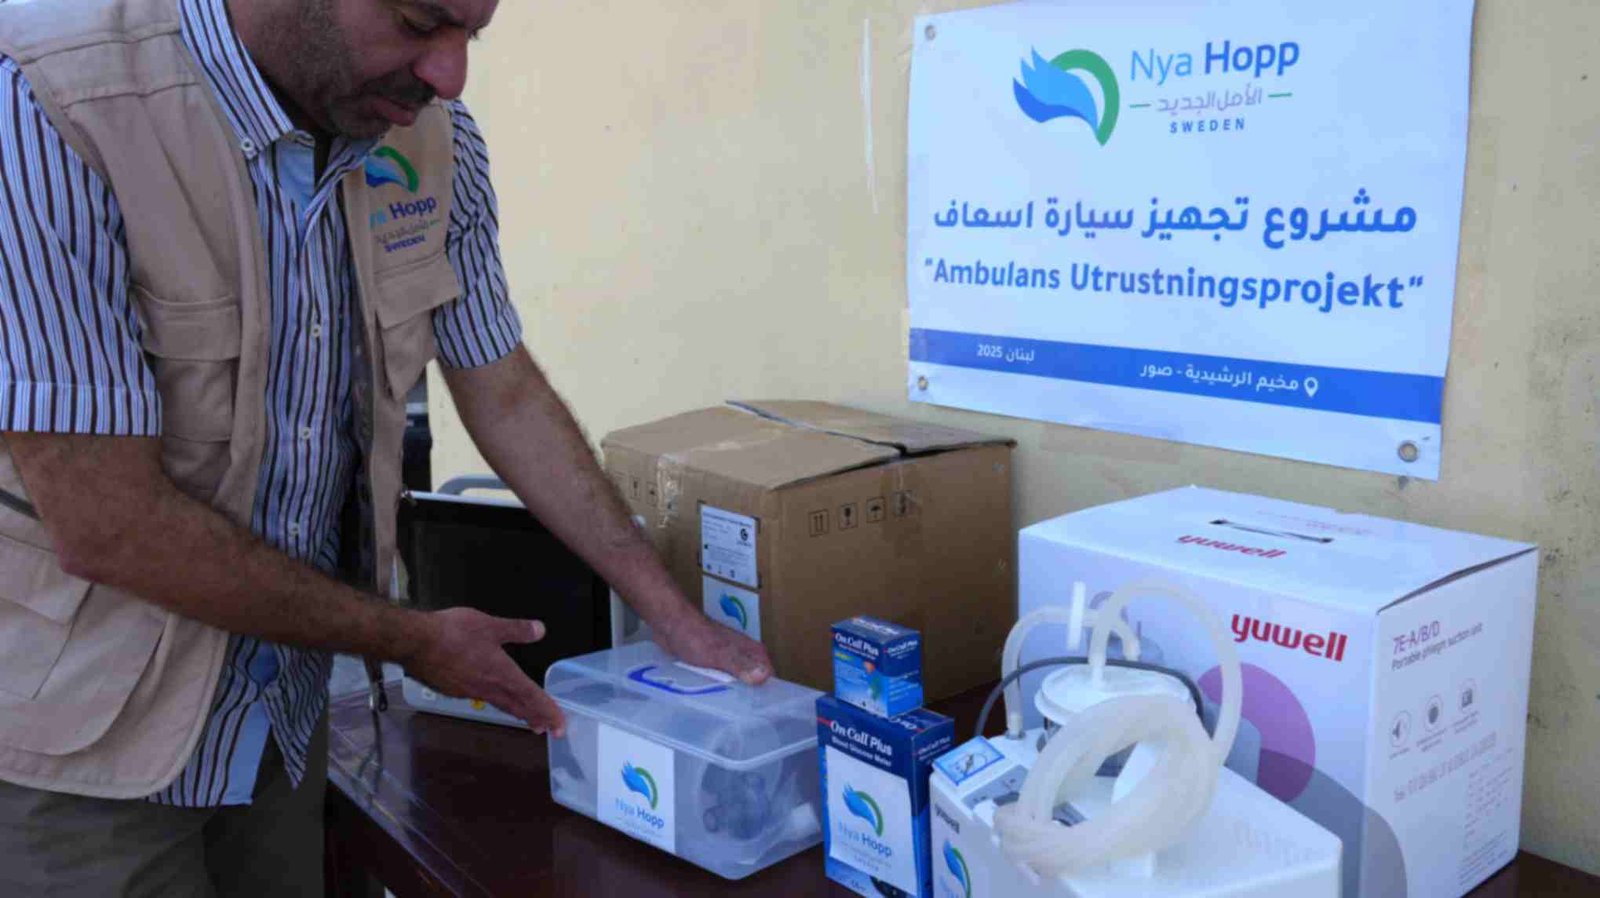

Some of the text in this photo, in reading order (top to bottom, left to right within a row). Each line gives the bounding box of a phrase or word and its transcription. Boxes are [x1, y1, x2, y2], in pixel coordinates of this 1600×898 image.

[1131, 40, 1300, 86] Nya Hopp
[1157, 83, 1263, 116] الأمل الجديد
[1169, 118, 1245, 134] SWEDEN
[389, 196, 437, 219] Hopp
[934, 187, 1417, 249] مشروع تجهيز سيارة اسعاف
[977, 343, 1035, 365] لبنان 2025
[1139, 363, 1173, 379] صور
[1185, 363, 1252, 388] الرشيدية
[1256, 374, 1299, 392] مخيم
[1177, 535, 1287, 559] yuwell
[1231, 614, 1348, 662] yuwell
[1393, 620, 1440, 655] 7E-A/B/D
[831, 720, 892, 756] On Call Plus
[637, 806, 664, 829] Hopp
[861, 832, 892, 857] Hopp
